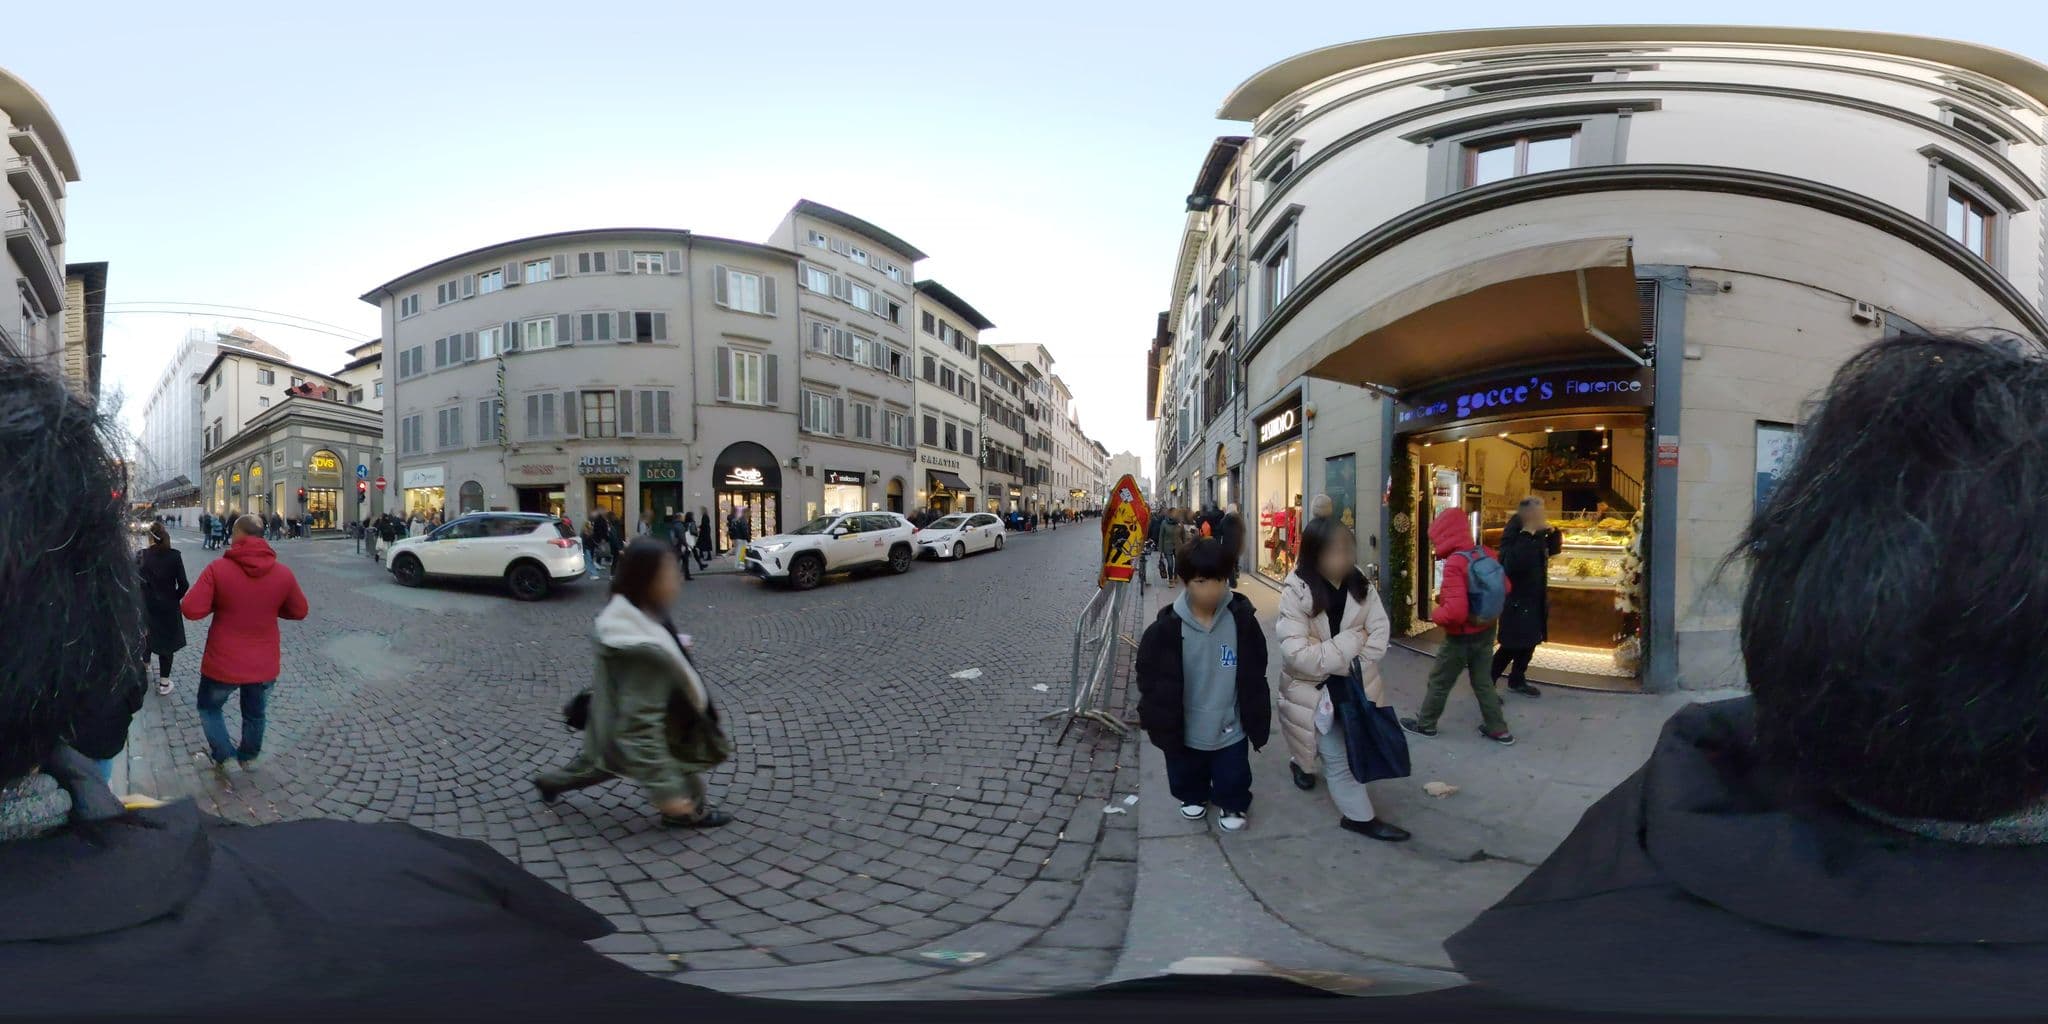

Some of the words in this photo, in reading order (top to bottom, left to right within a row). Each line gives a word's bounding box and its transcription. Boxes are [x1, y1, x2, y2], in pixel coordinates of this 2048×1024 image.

[1566, 380, 1642, 394] Florence
[578, 456, 618, 466] HOTEL
[577, 466, 632, 475] SPAGNA
[1221, 645, 1238, 666] LA
